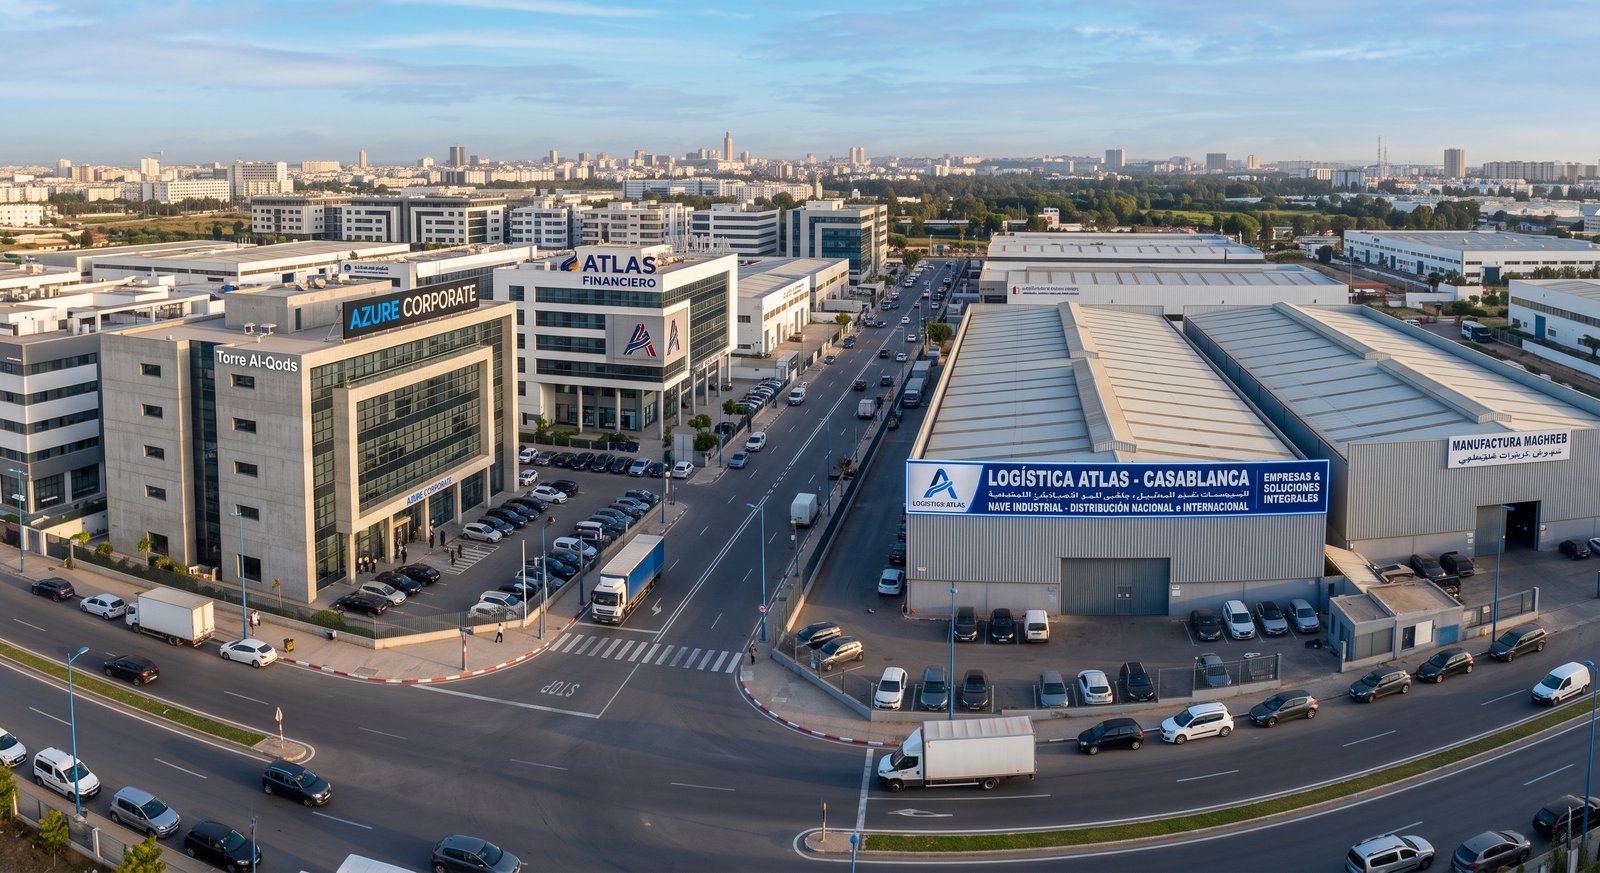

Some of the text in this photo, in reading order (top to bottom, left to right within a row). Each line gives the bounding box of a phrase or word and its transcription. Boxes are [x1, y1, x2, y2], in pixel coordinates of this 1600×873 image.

[582, 254, 656, 274] ATLAS
[583, 276, 656, 287] FINANCIERO
[350, 284, 476, 330] AZURE CORPORATE
[216, 350, 298, 372] Torre Al-Qods
[1452, 433, 1567, 451] MANUFACTURA MAGHREB
[988, 466, 1074, 488] LOGÍSTICA
[1078, 470, 1129, 488] ATLAS
[1143, 469, 1250, 488] CASABLANCA
[1264, 472, 1320, 482] EMPRESAS &
[1264, 483, 1320, 493] SOLUCIONES
[946, 501, 966, 509] ATLAS
[1264, 494, 1319, 504] INTEGRALES
[988, 502, 1010, 512] NAVE
[1013, 502, 1063, 513] INDUSTRIAL
[1070, 501, 1130, 513] DISTRIBUCIÓN
[1131, 502, 1174, 513] NACIONAL
[1176, 504, 1181, 513] e
[1183, 501, 1249, 512] INTERNACIONAL
[540, 680, 580, 697] STOP
